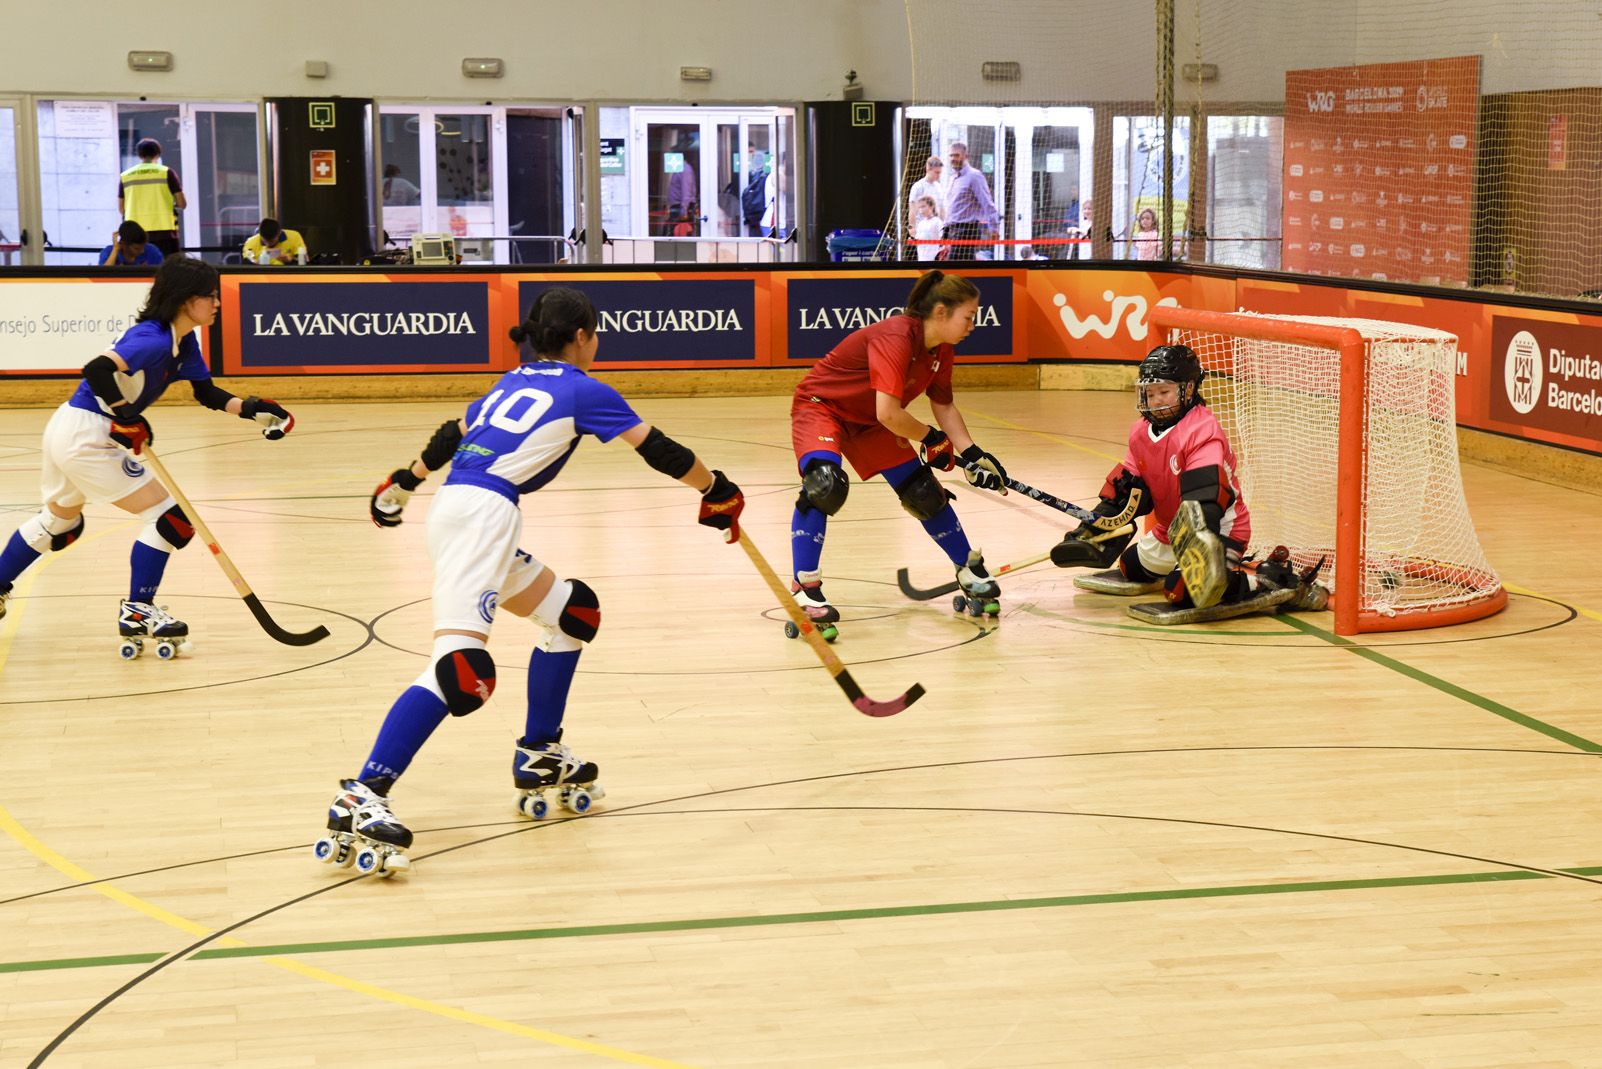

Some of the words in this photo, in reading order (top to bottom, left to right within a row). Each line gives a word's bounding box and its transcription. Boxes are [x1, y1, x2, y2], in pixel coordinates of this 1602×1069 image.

[42, 314, 101, 337] Superior
[106, 315, 123, 333] de
[253, 312, 291, 336] LA
[289, 311, 476, 336] VANGUARDIA
[595, 308, 743, 333] NGUARDIA
[799, 307, 832, 330] LA
[467, 388, 554, 434] 10
[1100, 505, 1136, 527] AZEMAD
